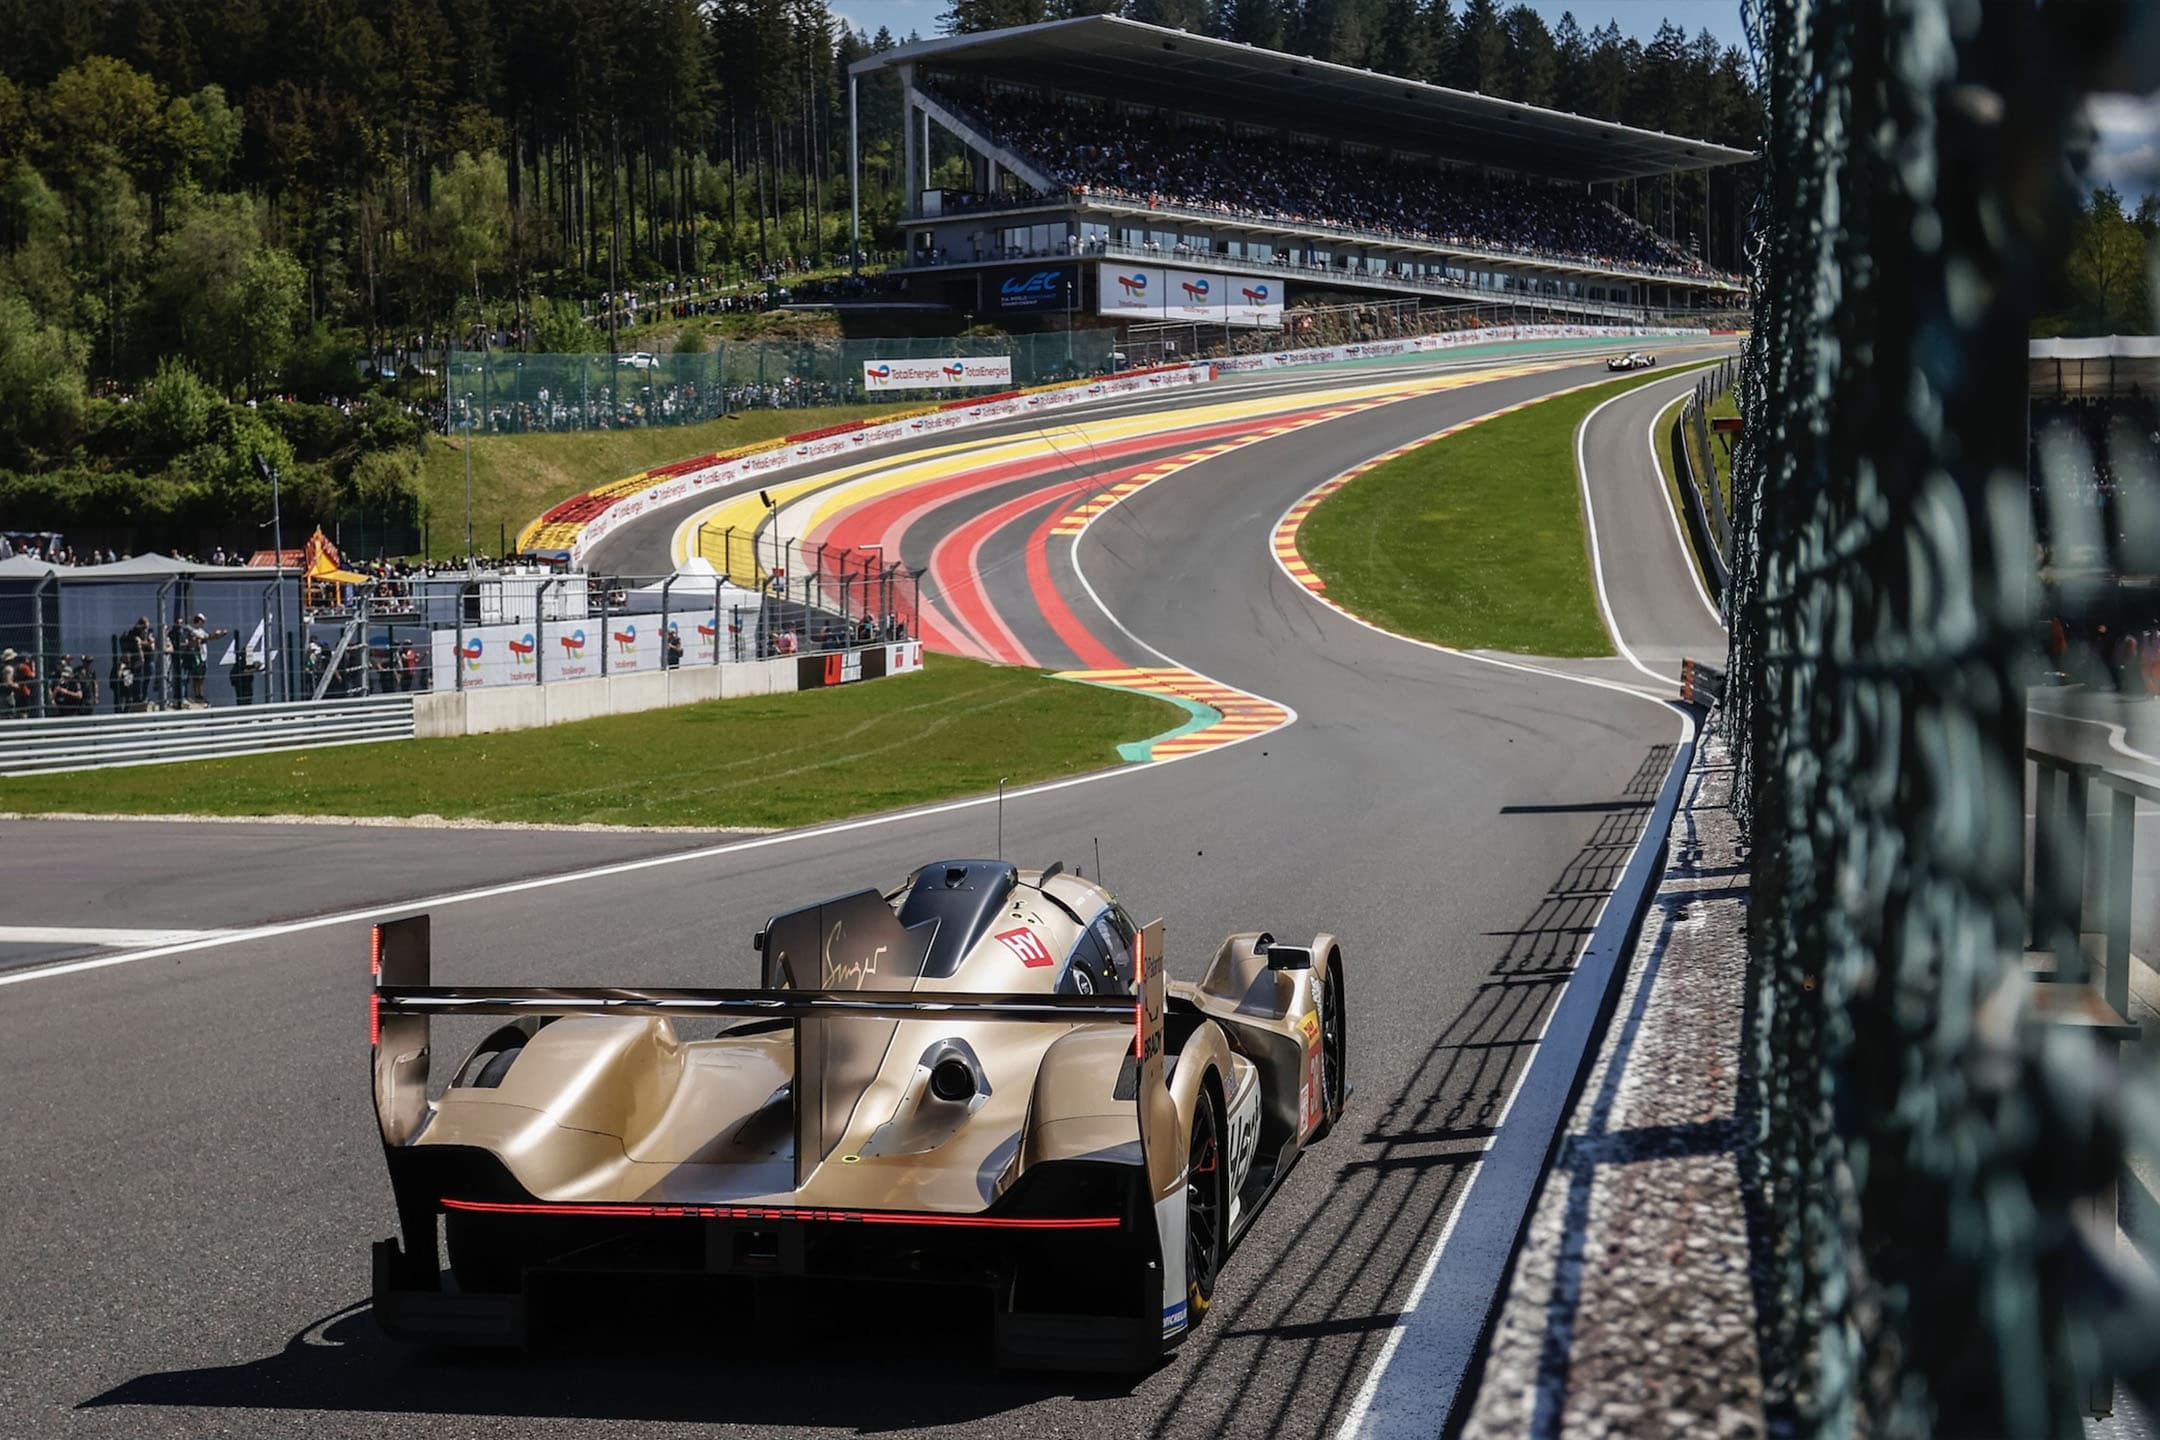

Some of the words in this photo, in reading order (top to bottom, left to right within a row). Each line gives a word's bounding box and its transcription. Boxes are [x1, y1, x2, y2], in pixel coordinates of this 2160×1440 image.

[1001, 271, 1061, 294] WEC
[891, 367, 939, 381] TotalEnergies
[965, 364, 1009, 379] TotalEnergies
[1002, 931, 1045, 961] HY
